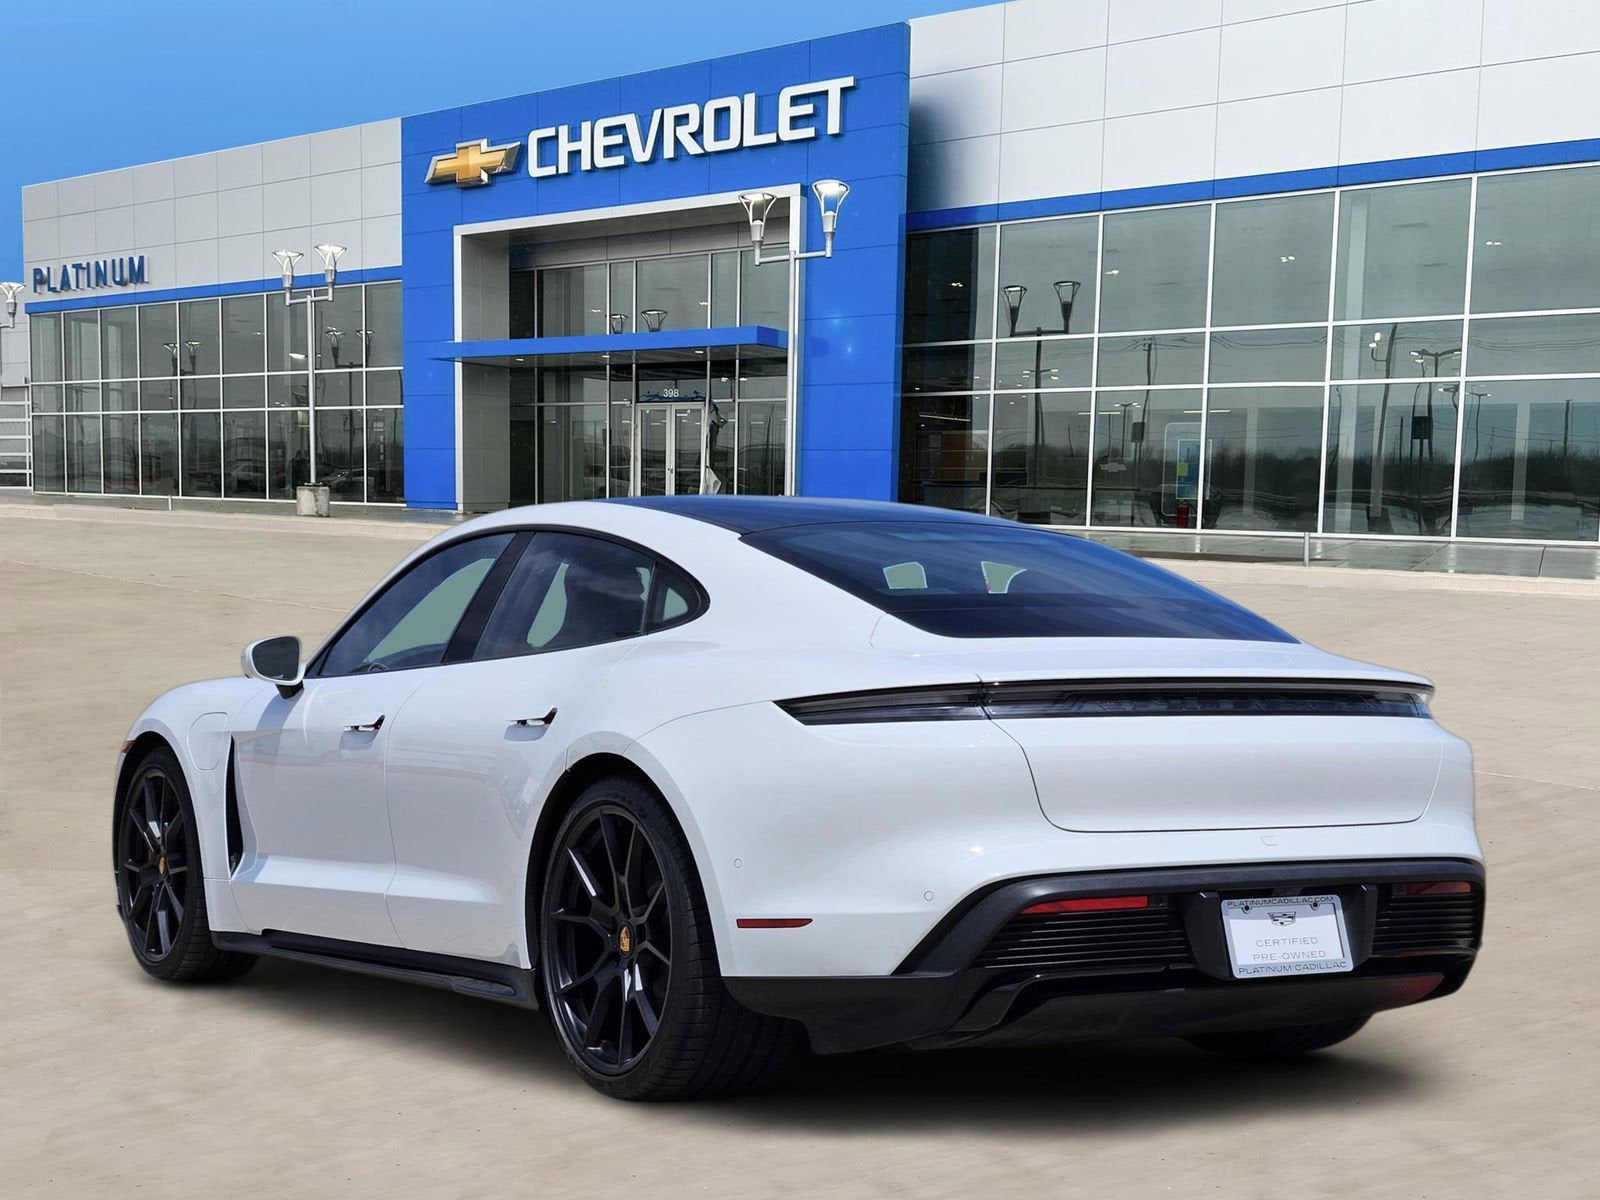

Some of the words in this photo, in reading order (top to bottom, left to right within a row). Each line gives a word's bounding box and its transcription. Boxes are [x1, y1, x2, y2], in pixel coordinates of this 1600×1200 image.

[527, 77, 855, 178] CHEVROLET
[33, 255, 146, 293] PLATINUM
[663, 388, 679, 398] 398
[1256, 938, 1319, 948] CERTIFIED
[1253, 951, 1326, 961] PRE-OWNED
[1239, 965, 1292, 975] PLATINUM
[1296, 961, 1348, 971] CADILLAC
